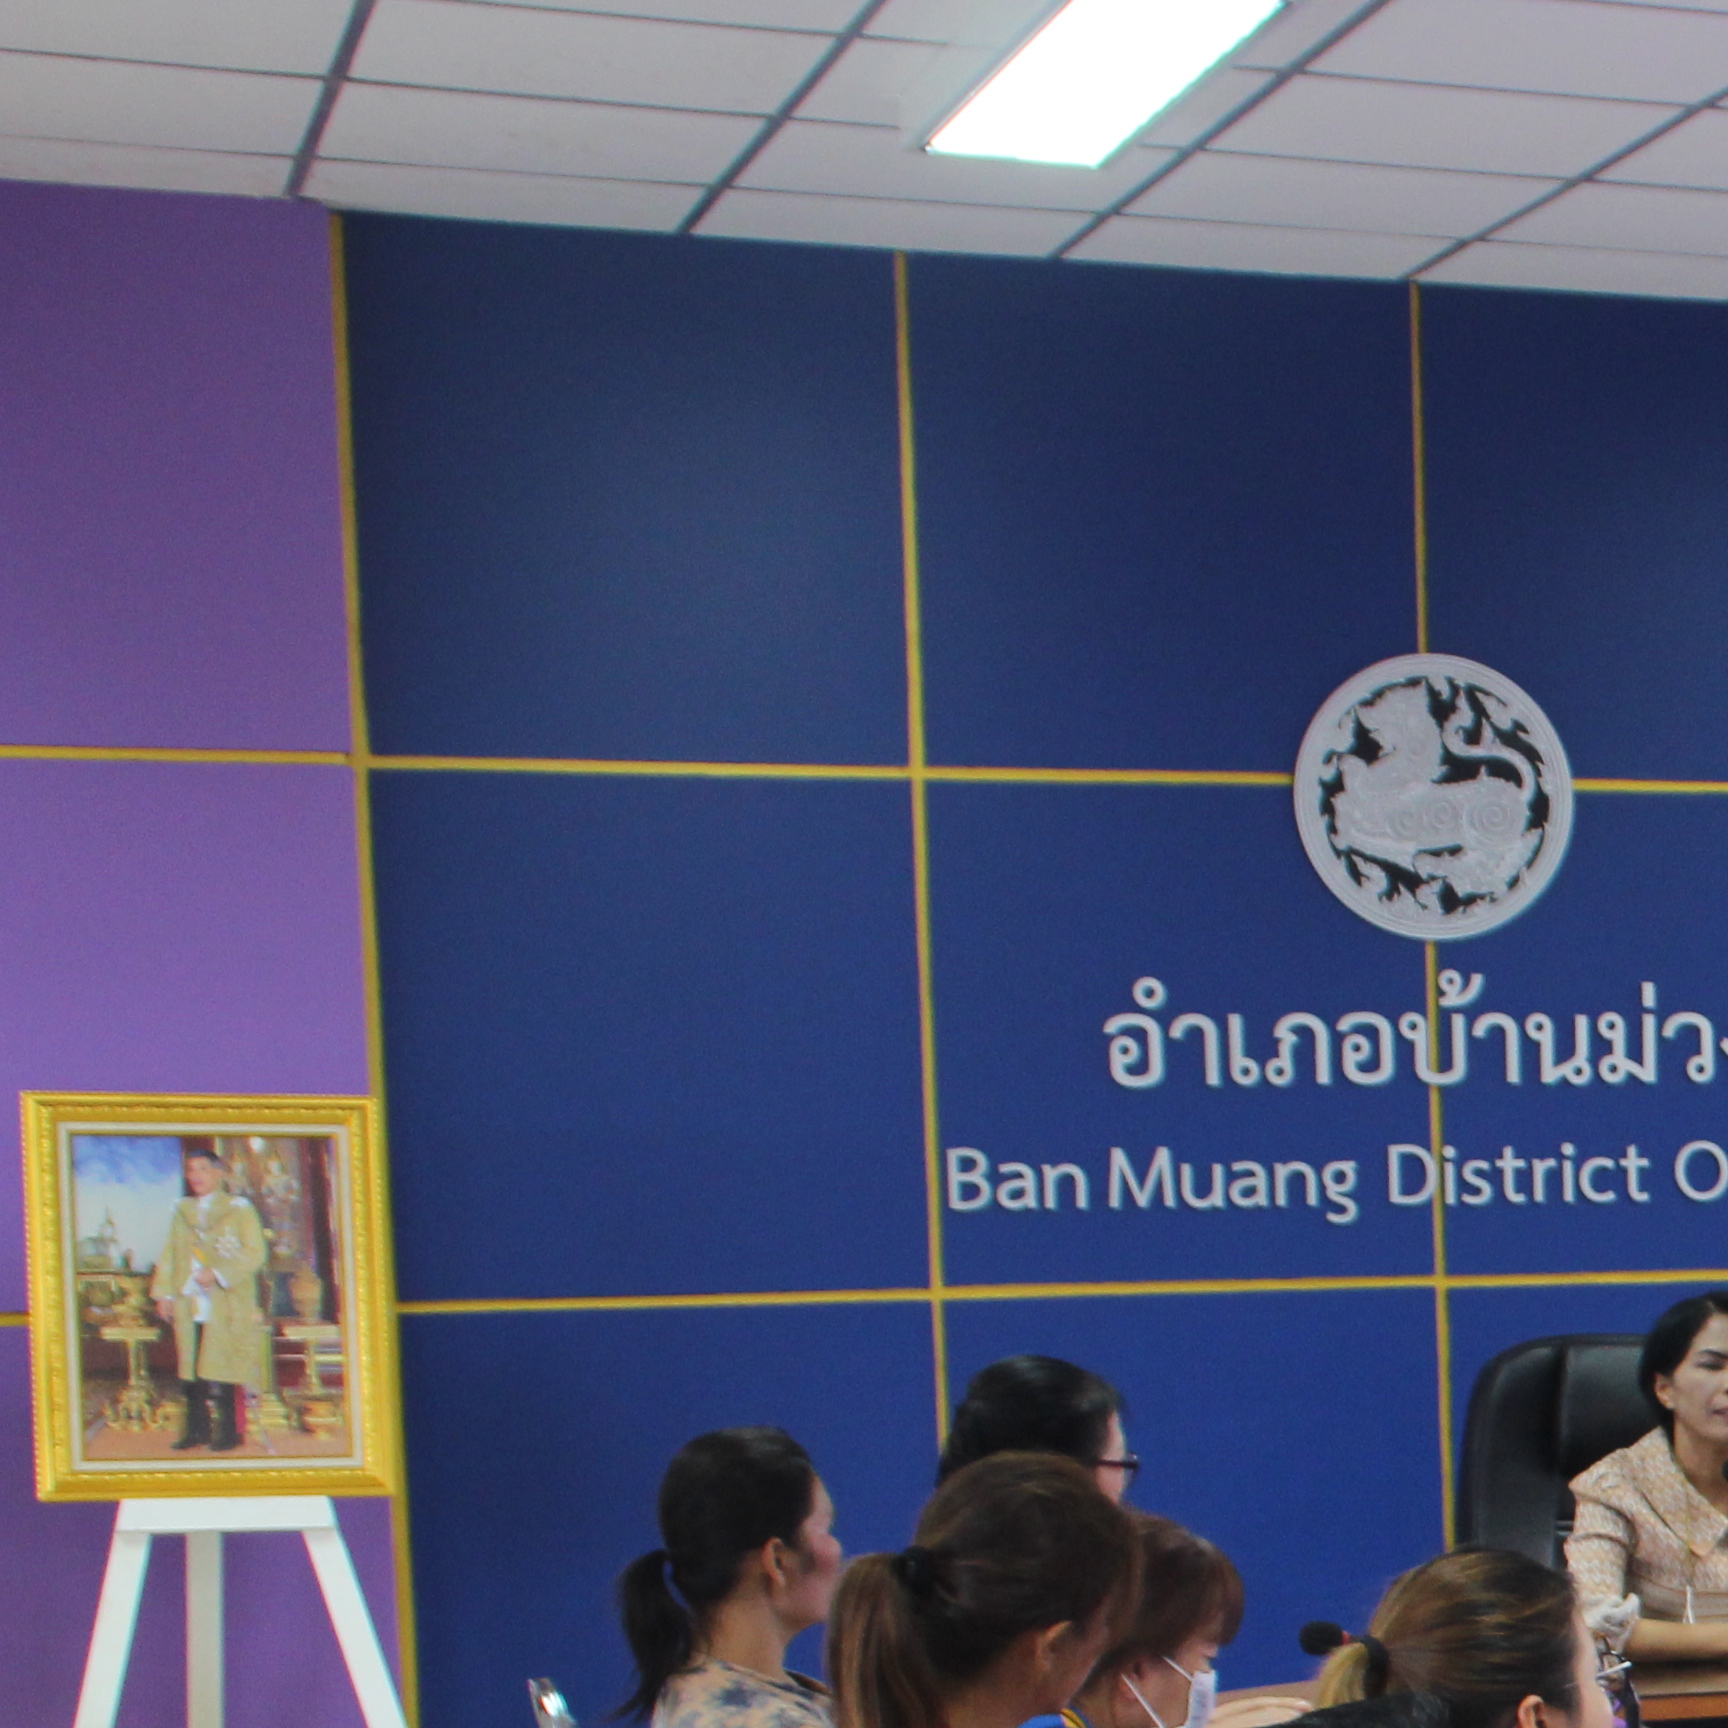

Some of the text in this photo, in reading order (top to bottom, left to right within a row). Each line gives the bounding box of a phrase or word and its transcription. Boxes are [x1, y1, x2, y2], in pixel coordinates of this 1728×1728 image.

[945, 1146, 1090, 1211] Ban
[1107, 1145, 1359, 1225] Muang
[1386, 1142, 1651, 1206] District
